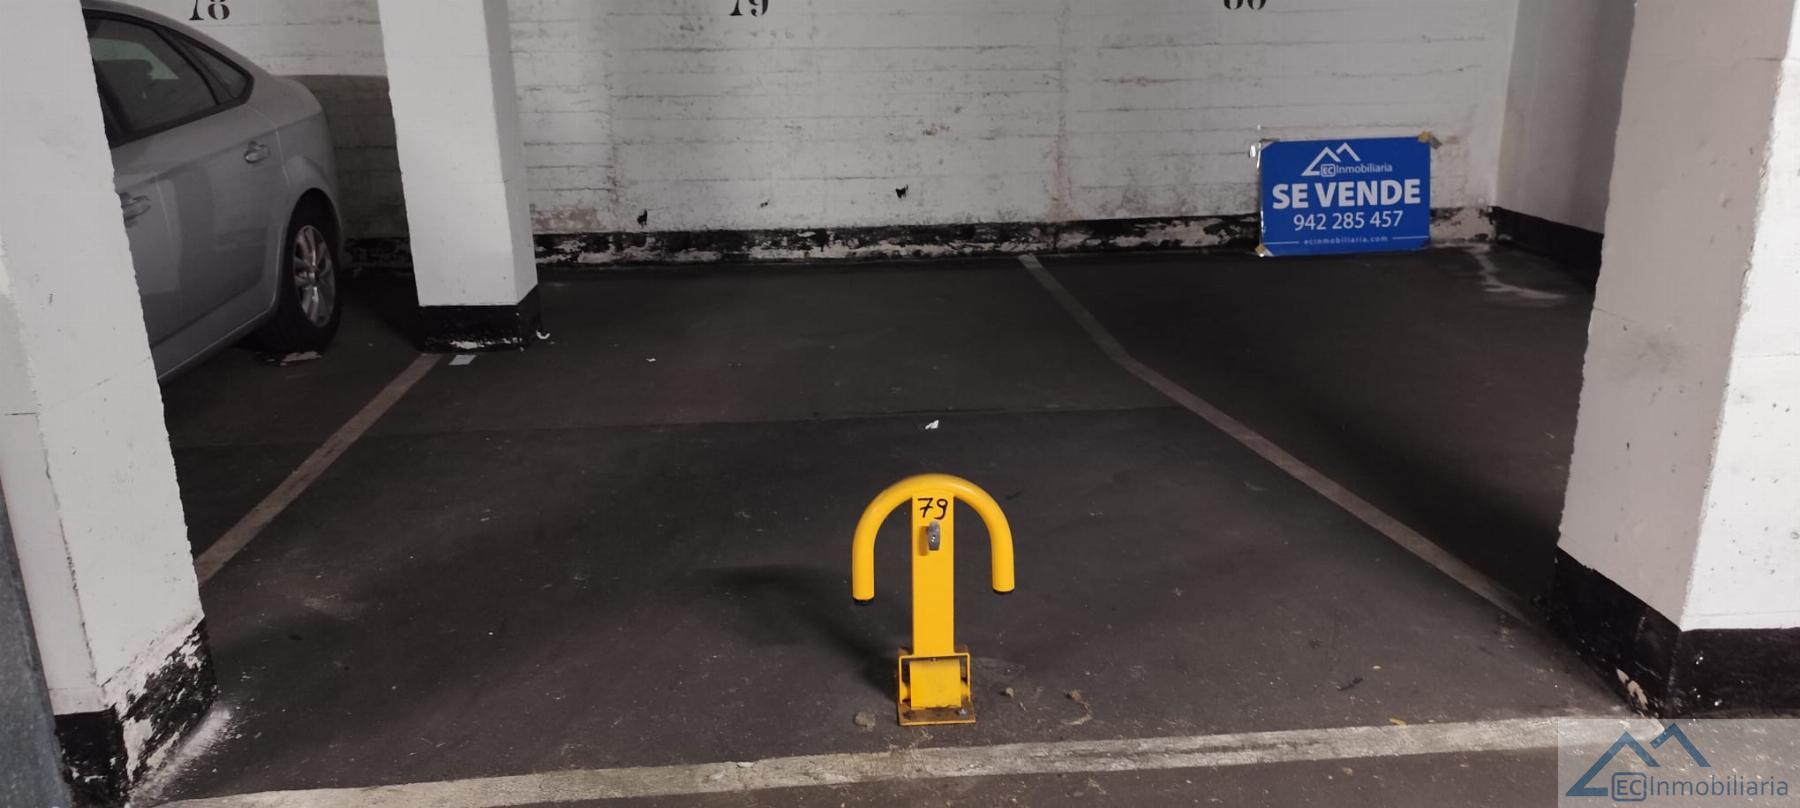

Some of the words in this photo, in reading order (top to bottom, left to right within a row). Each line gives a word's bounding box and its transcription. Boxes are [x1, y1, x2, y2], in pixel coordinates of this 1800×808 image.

[1272, 183, 1309, 210] SE
[1314, 179, 1421, 208] VENDE
[1293, 213, 1327, 231] 942
[1332, 211, 1365, 230] 285
[1370, 210, 1403, 228] 457
[1303, 236, 1389, 246] ecinmobiliaria.com
[917, 497, 949, 520] 79
